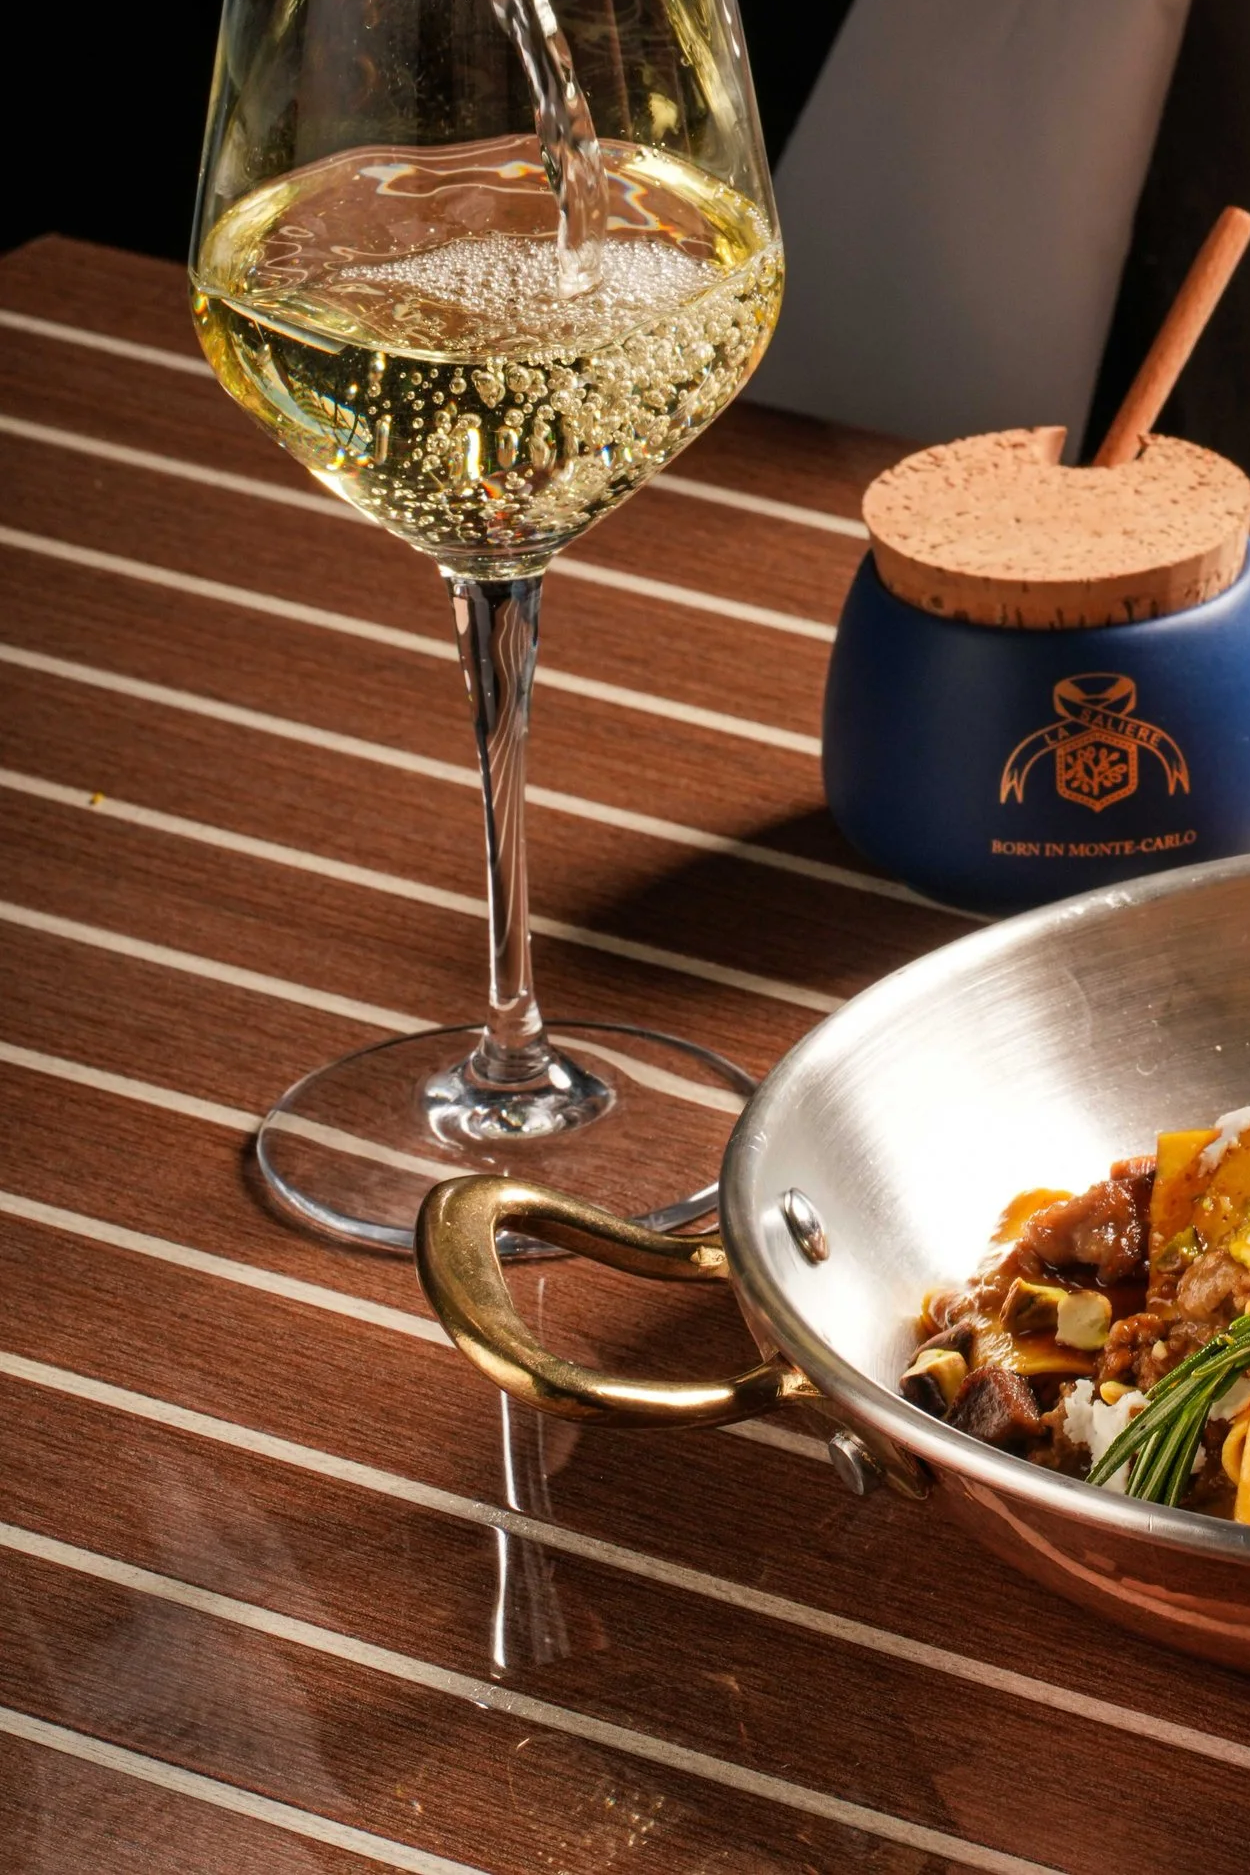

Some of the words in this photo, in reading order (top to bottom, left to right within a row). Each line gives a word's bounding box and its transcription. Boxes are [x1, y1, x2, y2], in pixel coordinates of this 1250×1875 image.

[1044, 725, 1070, 745] LA
[991, 838, 1041, 857] BORN
[1044, 841, 1064, 857] IN
[1068, 828, 1197, 857] MONTE-CARLO
